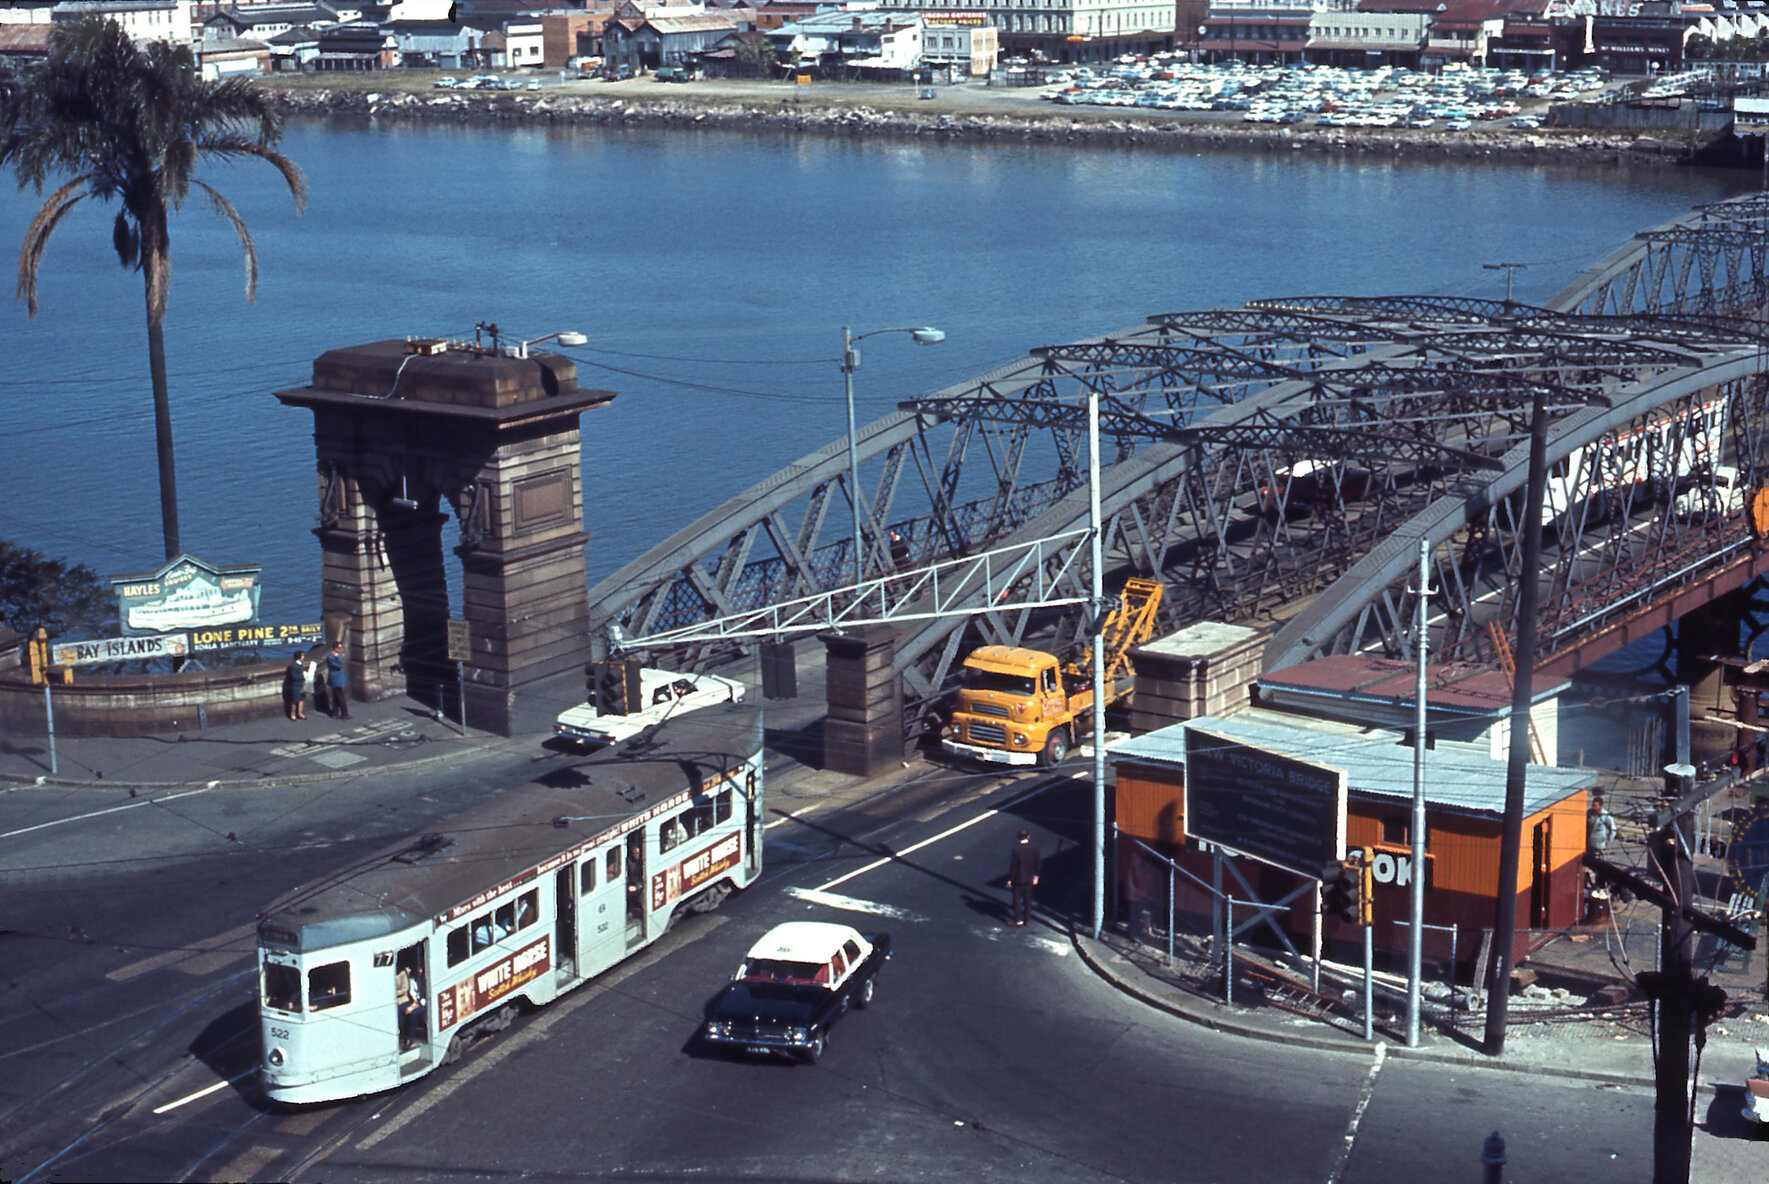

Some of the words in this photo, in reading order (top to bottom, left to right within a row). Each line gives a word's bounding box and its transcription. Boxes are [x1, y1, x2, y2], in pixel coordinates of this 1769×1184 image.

[123, 584, 160, 597] HAYLES
[193, 630, 233, 645] LONE
[238, 626, 274, 640] PINE
[77, 644, 100, 660] BAY
[107, 637, 163, 657] ISLANDS
[1230, 752, 1284, 780] VICTORIA
[1289, 770, 1332, 795] BRIDGE
[472, 893, 486, 907] with
[486, 888, 497, 900] the
[620, 811, 651, 834] WHITE
[652, 791, 689, 816] HORSE
[682, 851, 710, 880] WHITE
[711, 835, 739, 865] HORSE
[597, 921, 608, 934] 522
[374, 952, 393, 966] 77
[477, 960, 512, 994] WHITE
[513, 940, 547, 975] HORSE
[488, 979, 511, 1000] Scotch
[511, 965, 538, 988] Whisky
[270, 1026, 290, 1040] 522
